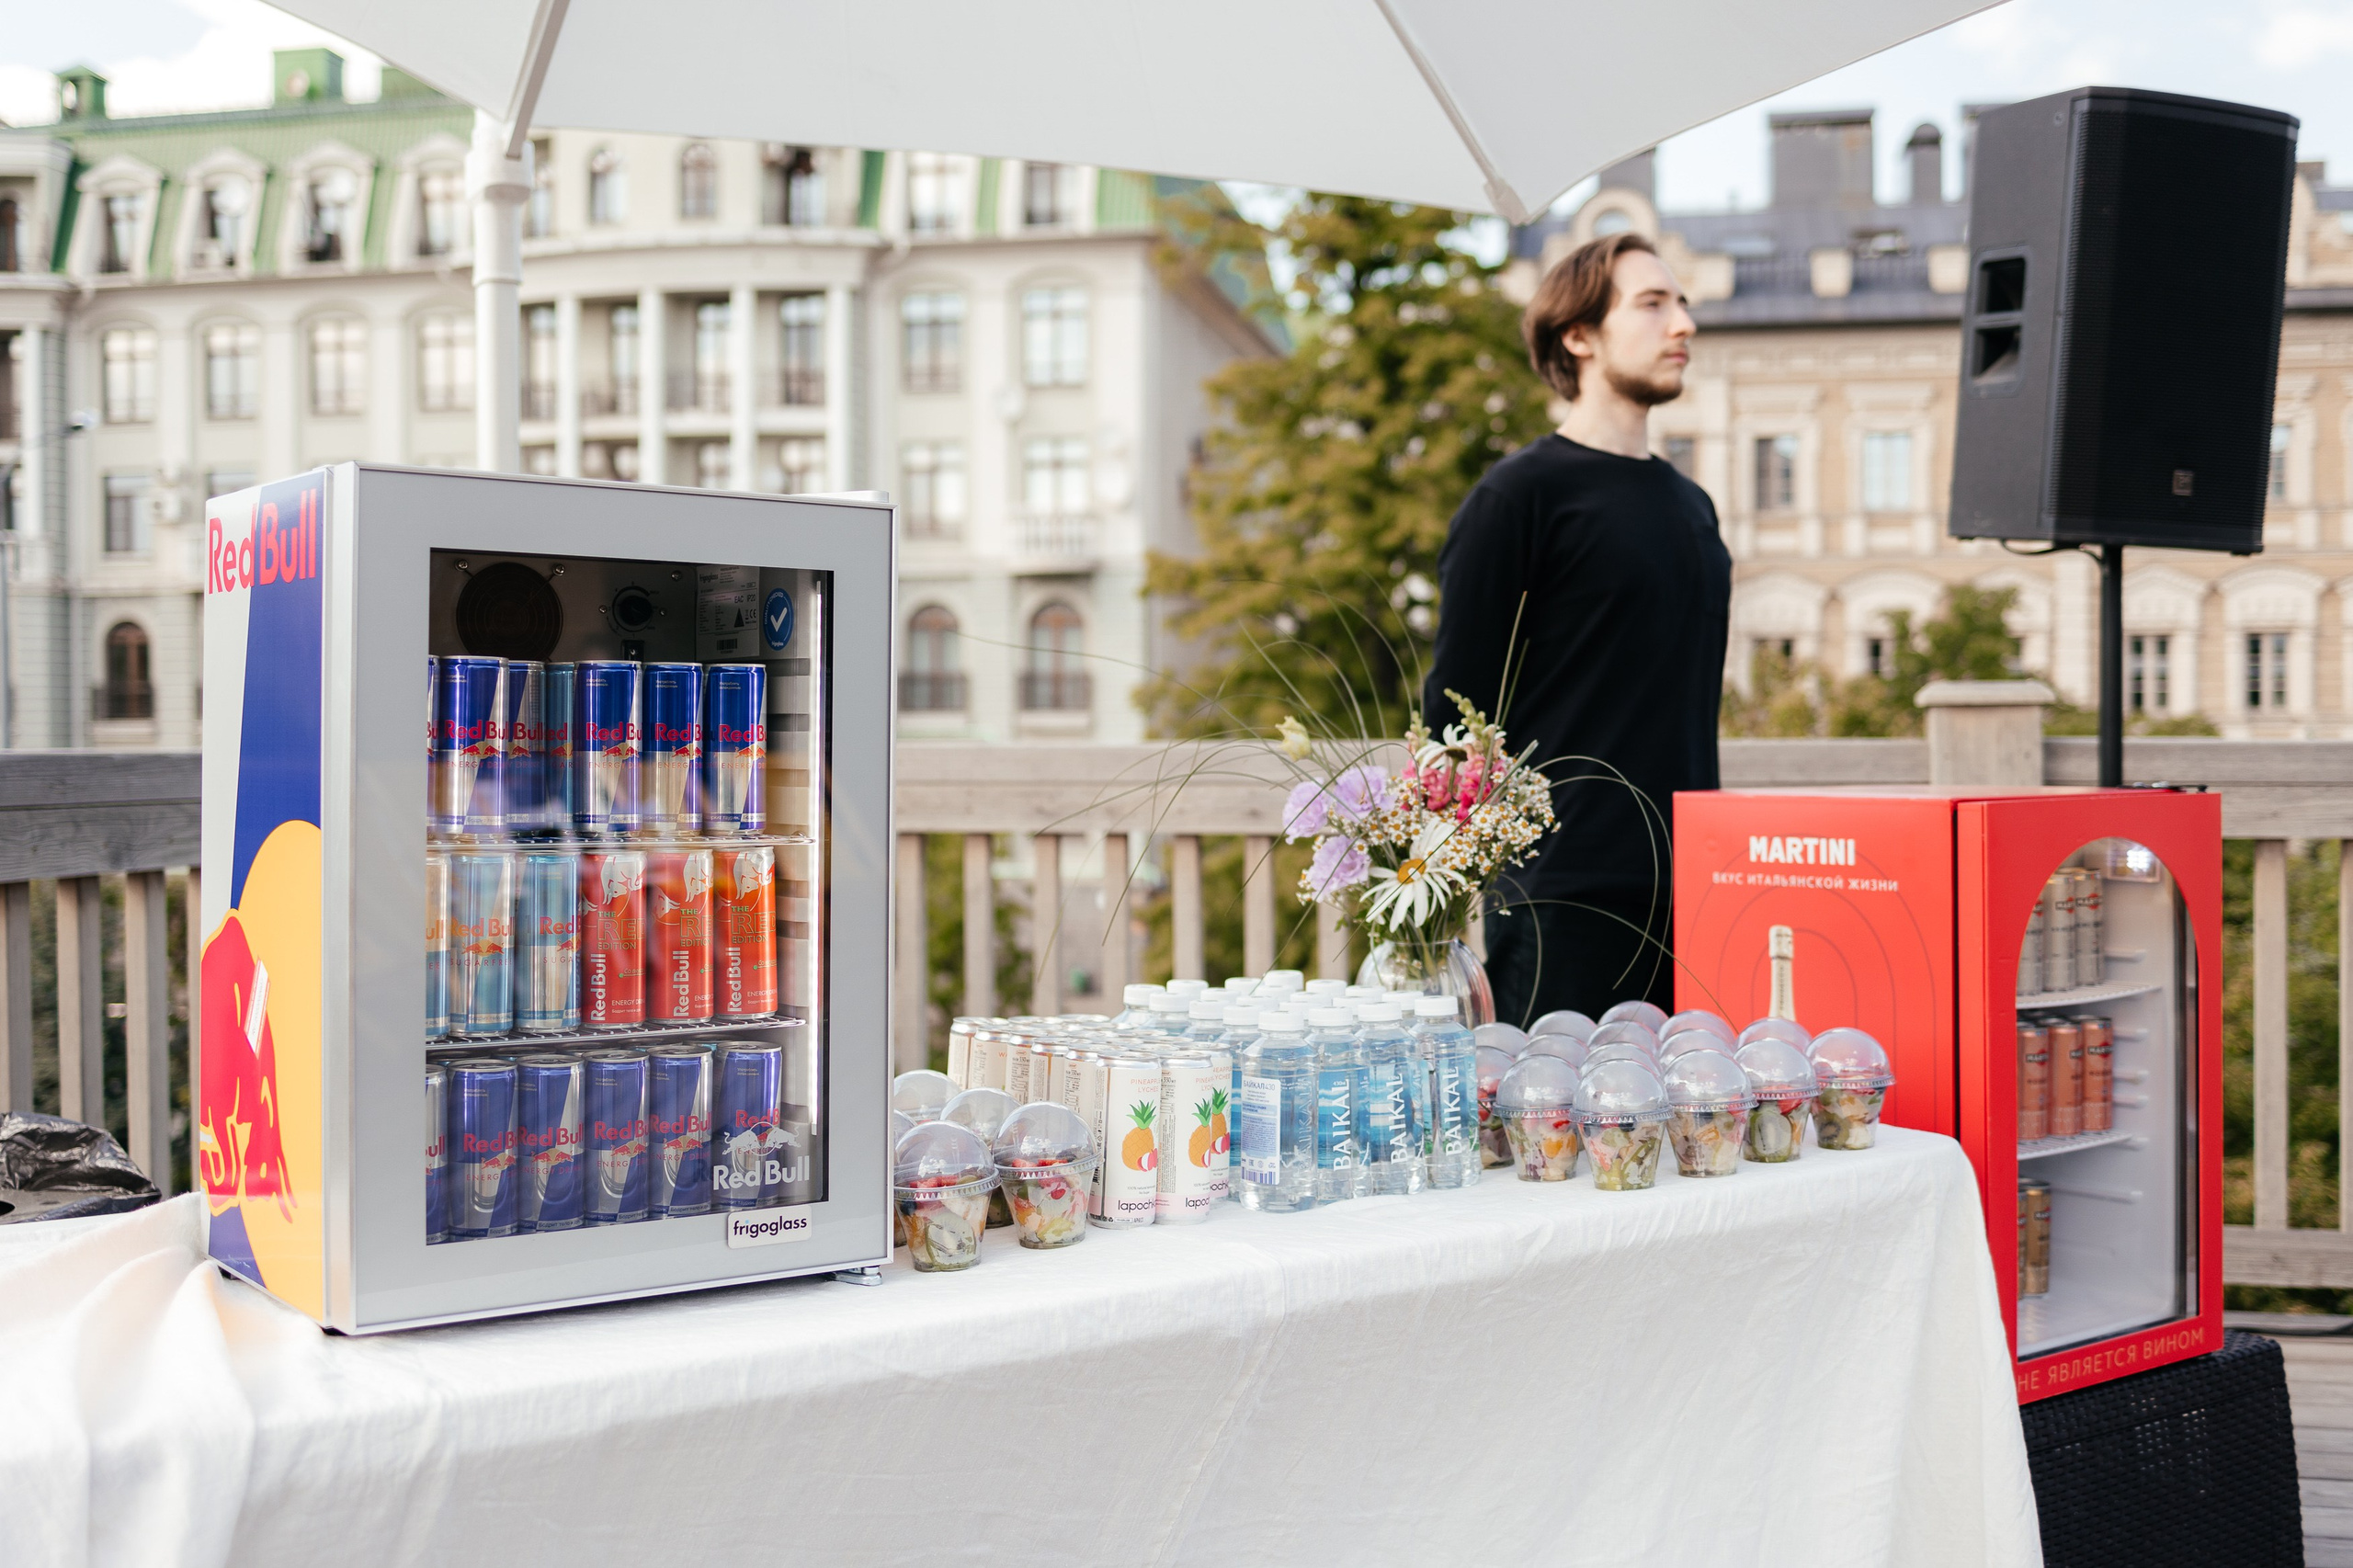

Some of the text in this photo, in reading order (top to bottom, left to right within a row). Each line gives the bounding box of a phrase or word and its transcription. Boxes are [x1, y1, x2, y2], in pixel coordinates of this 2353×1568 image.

[209, 488, 317, 595] Red Bull
[444, 720, 483, 740] Red
[585, 722, 623, 741] Red
[654, 722, 691, 742] Red
[719, 723, 755, 743] Red
[1749, 835, 1856, 866] MARTINI
[1712, 871, 1899, 892] ВКУС ИТАЛЬЯНСКОЙ ЖИЗНИ
[450, 916, 484, 937] Red
[539, 915, 575, 936] Red
[597, 941, 637, 950] EDITION
[590, 953, 607, 1021] Red Bull
[672, 950, 689, 1017] Red Bull
[725, 947, 743, 1012] Red Bull
[735, 1108, 771, 1128] Red
[1386, 1073, 1408, 1164] BAIKAL
[1442, 1066, 1462, 1156] BAIKAL
[594, 1120, 632, 1140] Red
[650, 1114, 685, 1134] Red
[1332, 1078, 1351, 1170] BAIKAL
[463, 1132, 503, 1153] Red
[519, 1125, 552, 1147] Red
[713, 1155, 810, 1190] Red Bull
[733, 1216, 807, 1238] frigoglass
[2018, 1327, 2204, 1392] НЕ ЯВЛЯЕТСЯ ВИНОМ
